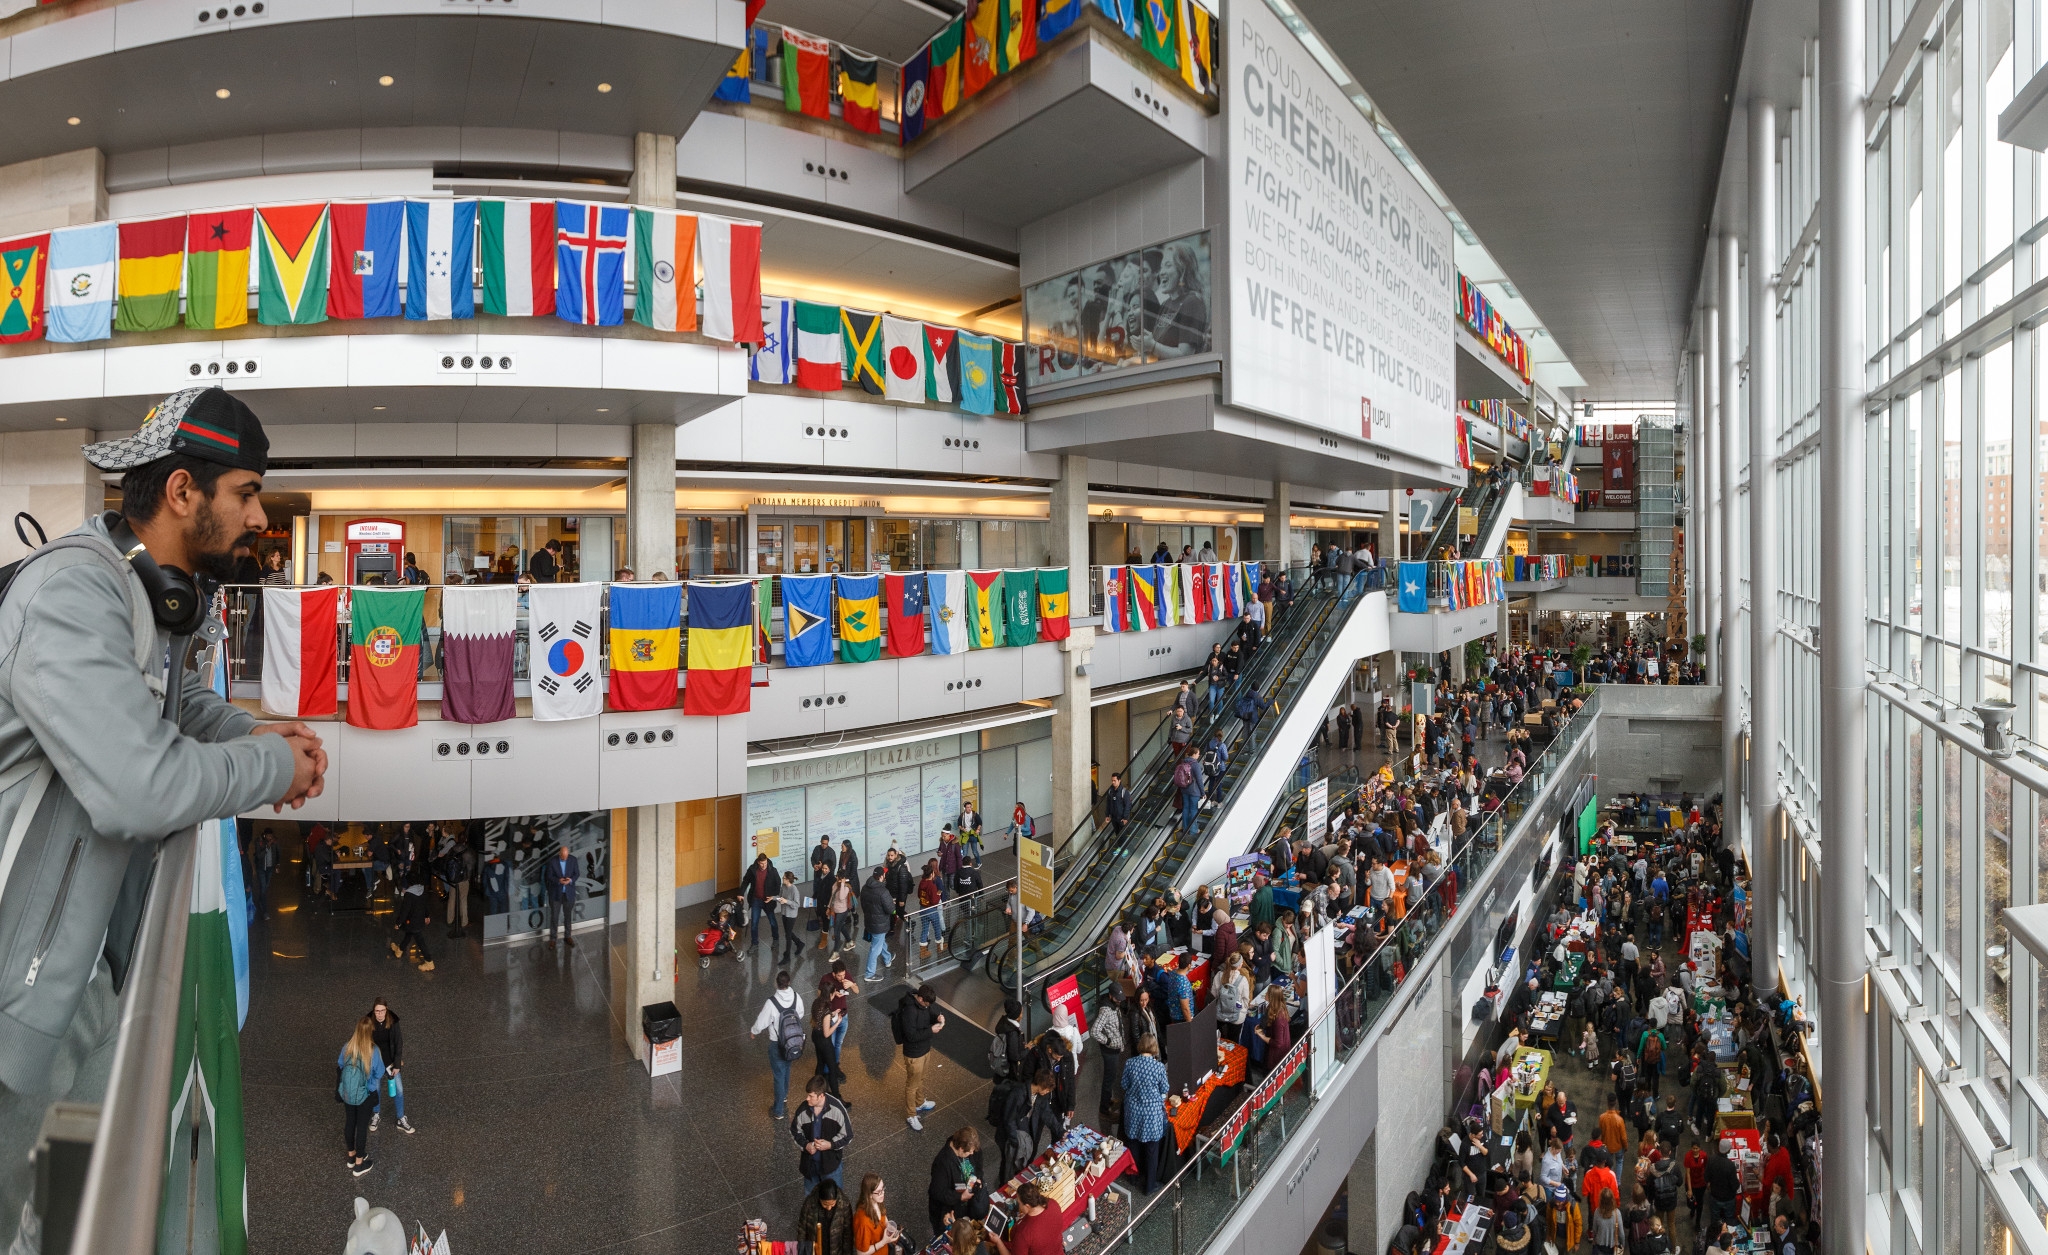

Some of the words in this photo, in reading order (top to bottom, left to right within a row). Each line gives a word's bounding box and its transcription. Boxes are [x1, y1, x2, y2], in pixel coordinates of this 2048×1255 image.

[1242, 19, 1301, 99] PROUD
[1305, 87, 1332, 133] ARE
[1335, 115, 1359, 162] THE
[1361, 144, 1399, 203] VOICES
[1400, 190, 1428, 234] LIFTED
[1243, 116, 1294, 176] HERE'S
[1296, 160, 1312, 192] TO
[1315, 177, 1337, 214] THE
[1243, 64, 1374, 219] CHEERING
[1379, 193, 1411, 255] FOR
[1416, 231, 1450, 292] IUPUI
[1244, 155, 1302, 226] FIGHT,
[1306, 206, 1373, 279] JAGUARS,
[1375, 259, 1411, 306] FIGHT!
[1413, 290, 1426, 317] GO
[1427, 304, 1450, 336] JAGS!
[1245, 200, 1297, 258] WE'RE
[1300, 237, 1352, 294] RAISING
[1355, 276, 1369, 303] BY
[1370, 287, 1389, 319] THE
[1391, 304, 1422, 342] POWER
[1424, 328, 1433, 348] OF
[1245, 240, 1284, 283] BOTH
[1287, 264, 1335, 312] INDIANA
[1337, 298, 1359, 325] AND
[1397, 335, 1424, 366] DOUBLY
[1038, 325, 1126, 376] ROR
[1246, 277, 1317, 345] WE'RE
[1322, 318, 1366, 368] EVER
[1368, 344, 1404, 388] TRUE
[1406, 365, 1422, 397] TO
[1425, 376, 1451, 412] IUPUI
[1372, 405, 1391, 430] IUPUI
[1536, 428, 1545, 451] 3
[753, 497, 787, 506] INDIANA
[791, 498, 826, 507] MEMBERS
[829, 499, 855, 507] CREDIT
[859, 500, 881, 508] UNION
[1419, 499, 1433, 533] 2
[1224, 527, 1237, 562] 2
[1423, 683, 1432, 716] 1
[772, 755, 862, 784] DEMOCRACY
[1045, 846, 1054, 871] 2
[1050, 987, 1079, 1009] RESEARCH
